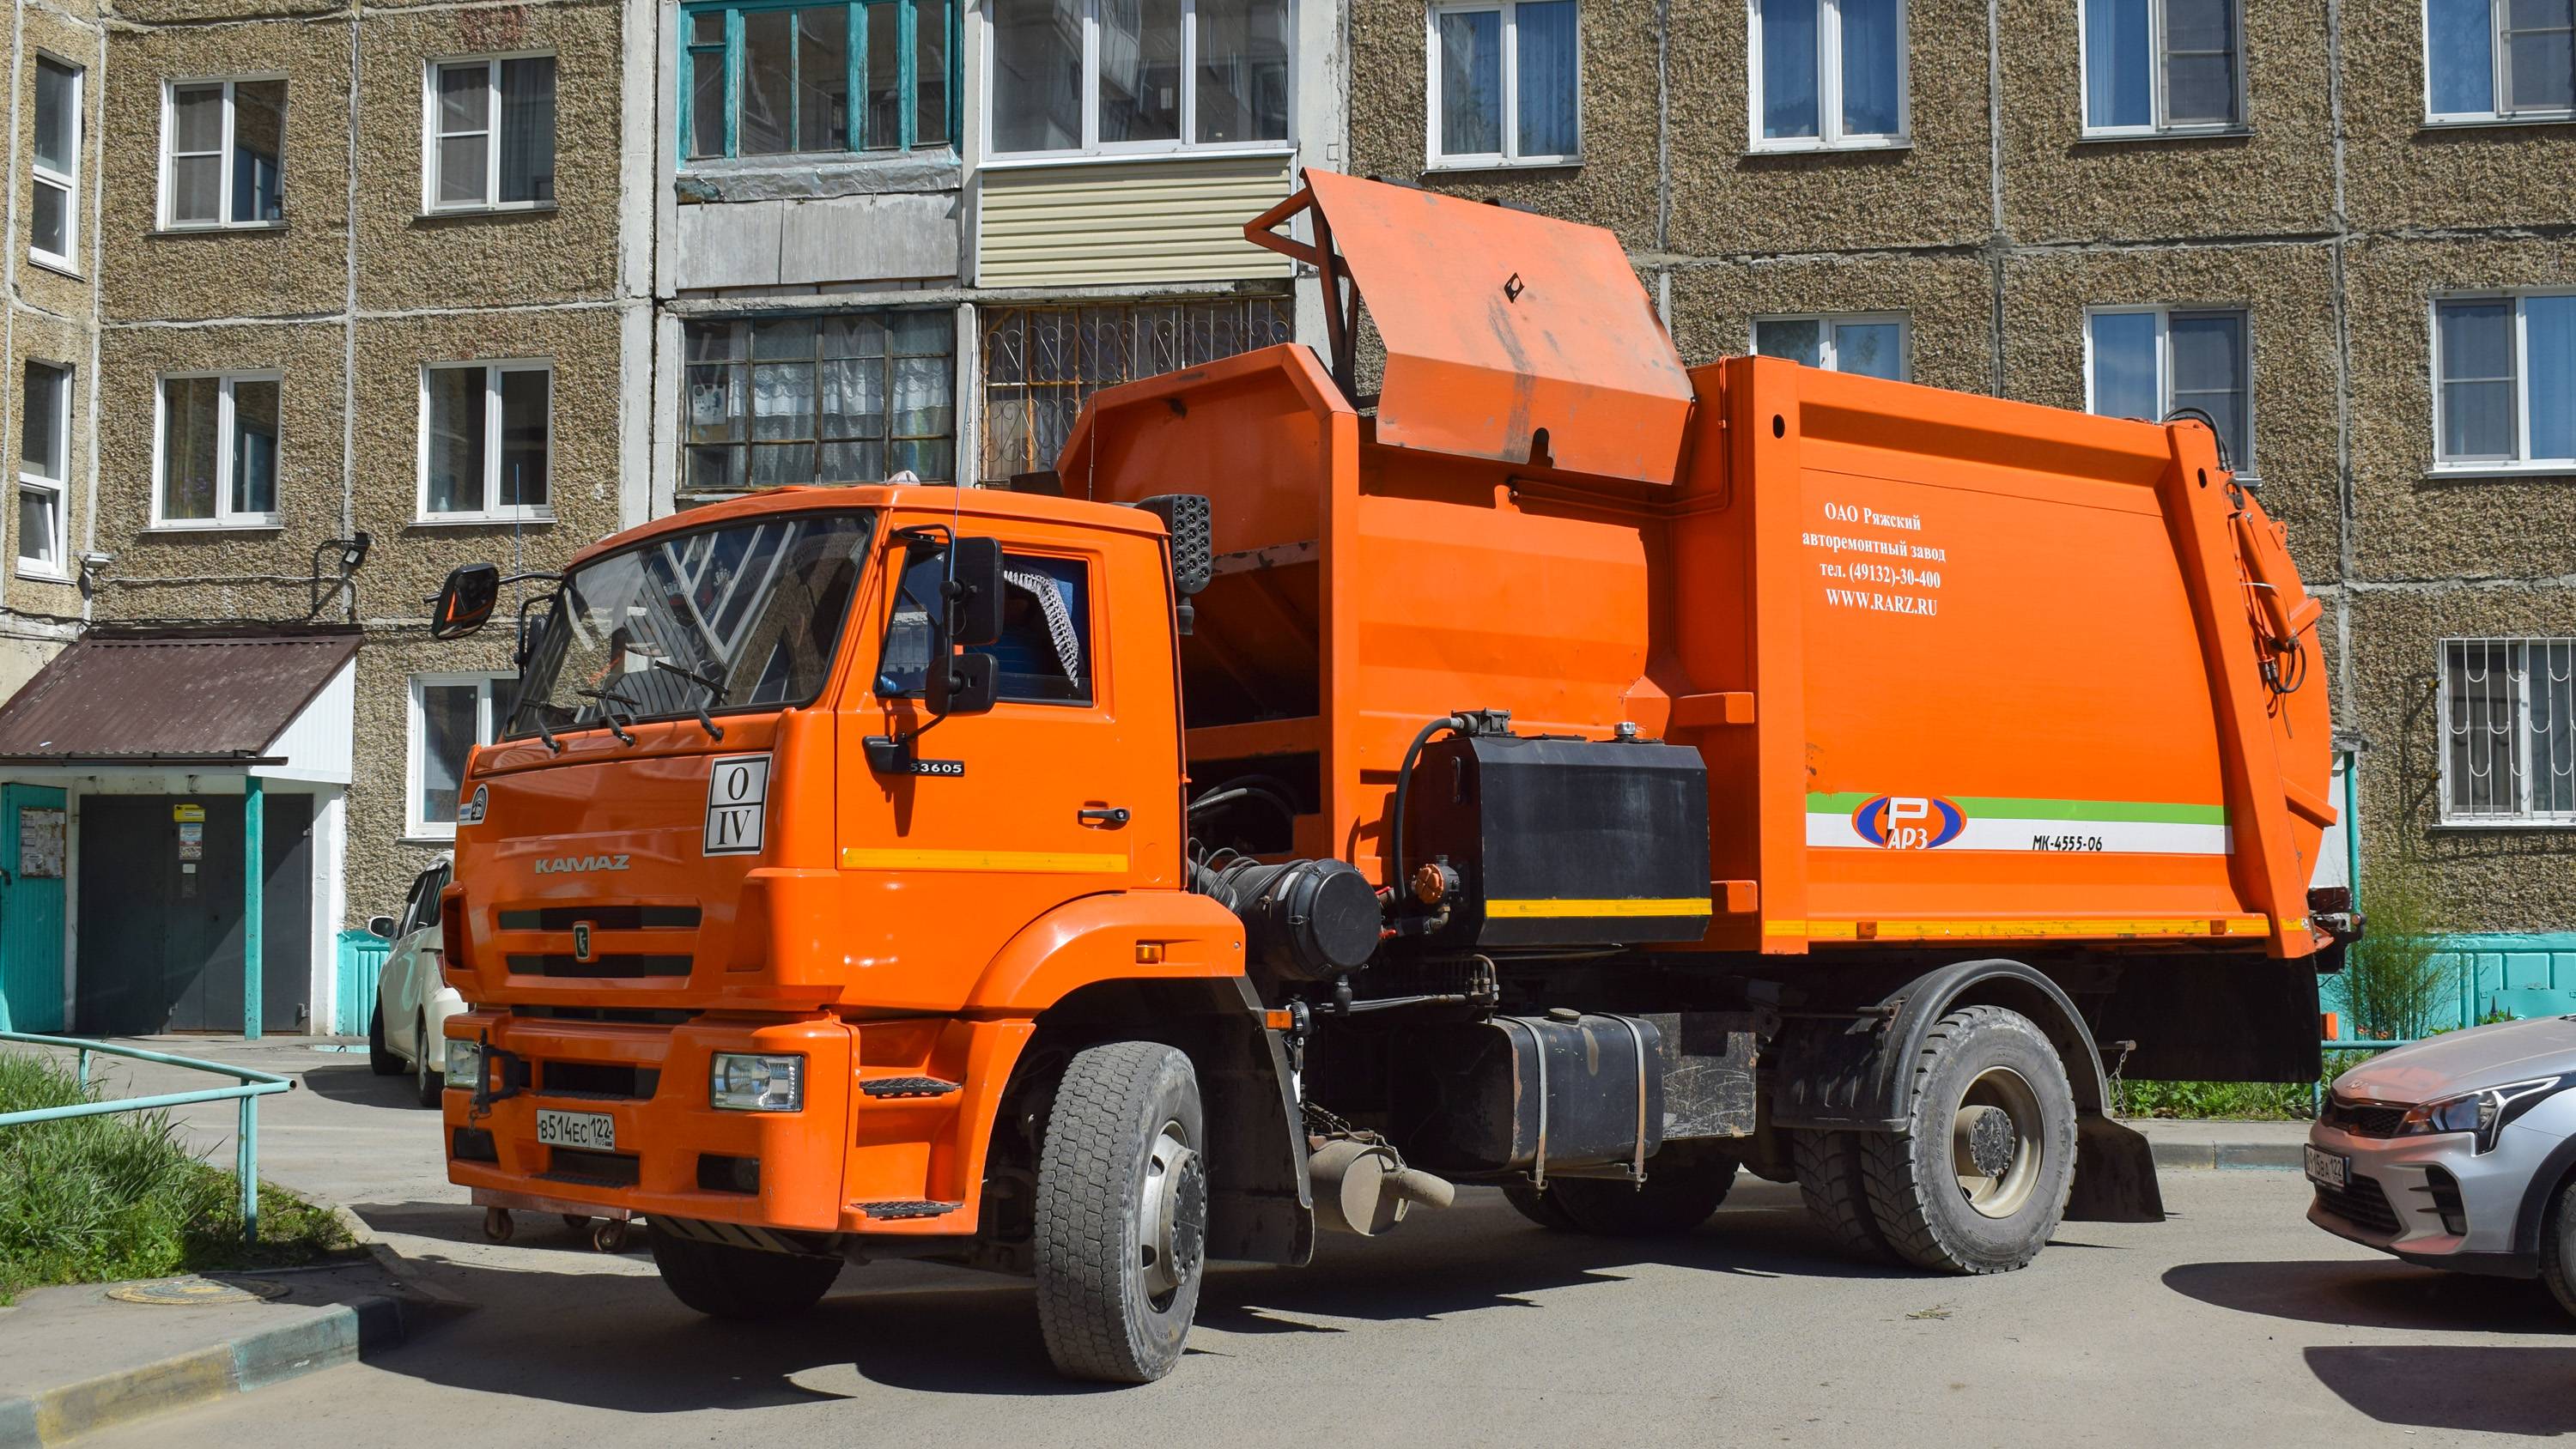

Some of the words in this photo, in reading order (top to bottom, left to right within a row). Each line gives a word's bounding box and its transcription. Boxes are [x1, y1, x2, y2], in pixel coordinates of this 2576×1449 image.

[1825, 502, 1858, 522] ОАО
[1863, 507, 1922, 530] Ряжский
[1802, 531, 1908, 557] авторемонтный
[1911, 545, 1946, 562] завод
[1820, 562, 1846, 578] тел.
[1849, 562, 1941, 588] (49132)-30-400
[1826, 588, 1938, 616] WWW.RARZ.RU
[910, 762, 963, 773] 53605
[717, 809, 752, 845] IV
[535, 854, 630, 874] KAMAZ
[590, 1118, 611, 1138] 122
